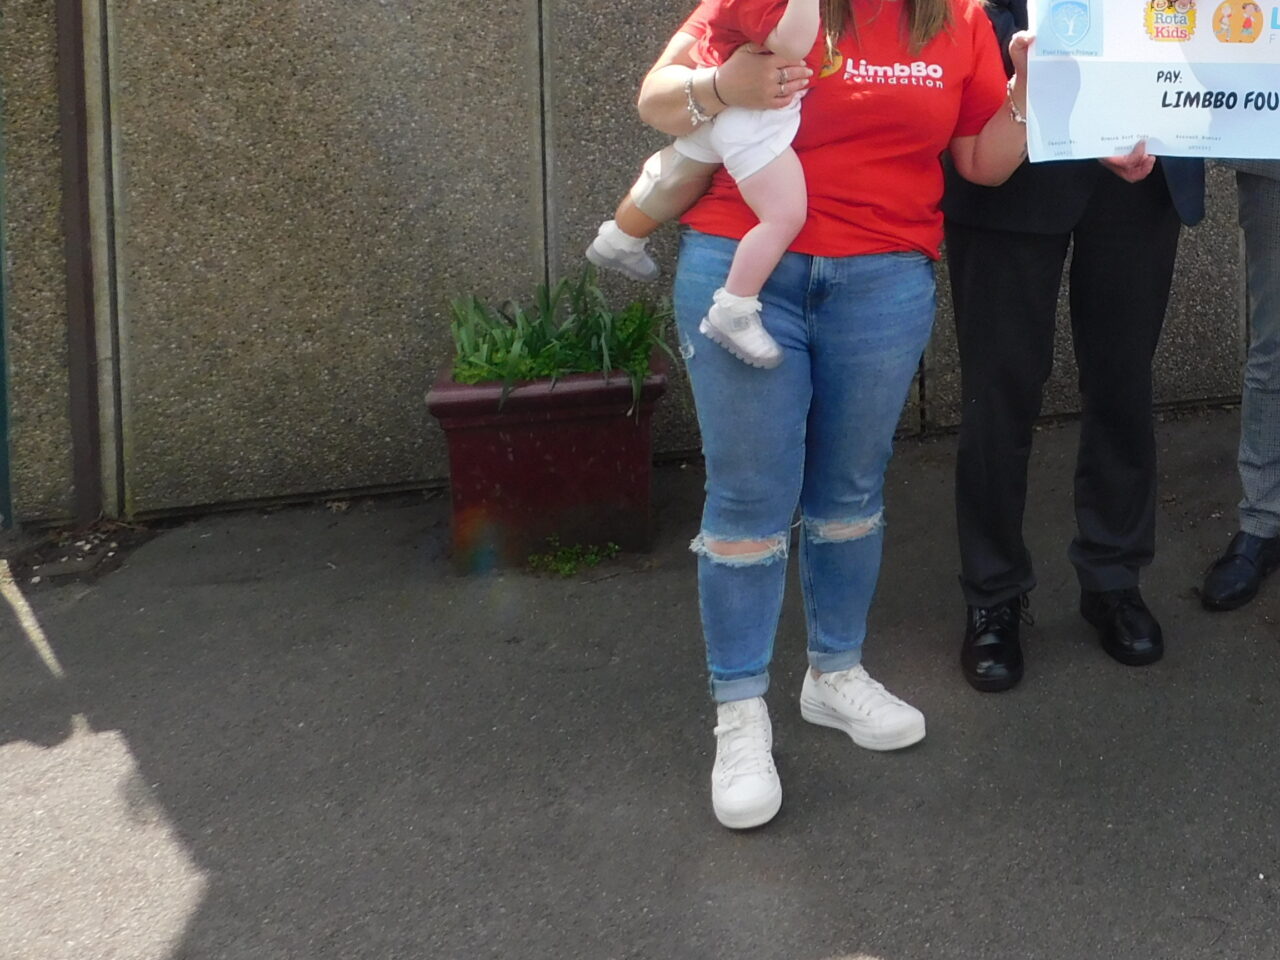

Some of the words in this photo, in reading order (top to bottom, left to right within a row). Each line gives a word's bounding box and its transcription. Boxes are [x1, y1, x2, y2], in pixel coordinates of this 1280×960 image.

[1154, 12, 1188, 25] Rota
[1153, 25, 1188, 39] Kids
[845, 57, 944, 79] LimbBo
[843, 71, 944, 89] Foundation
[1156, 70, 1183, 84] PAY:
[1161, 90, 1238, 110] LIMBBO
